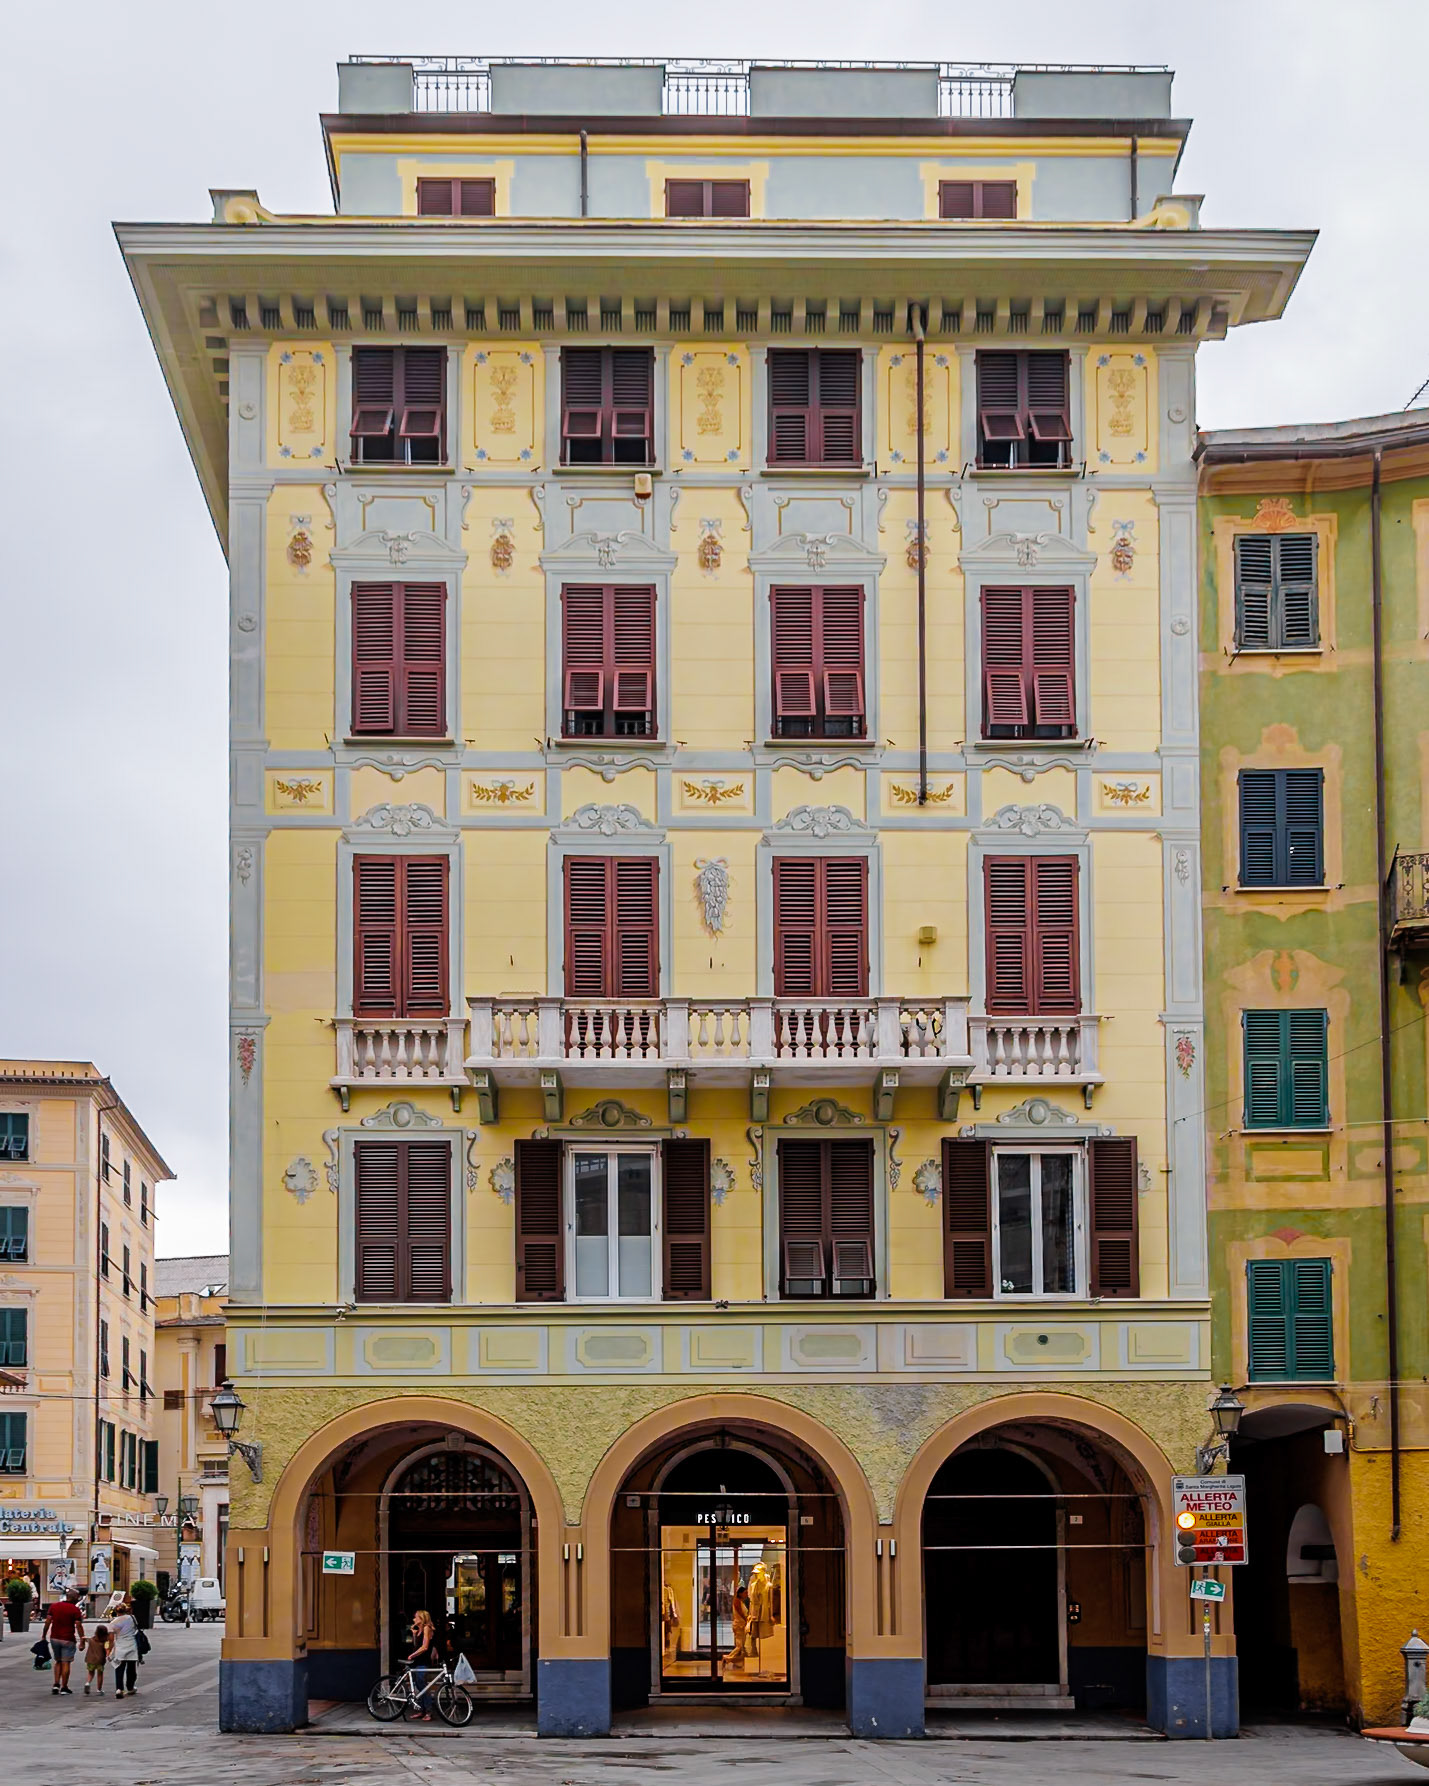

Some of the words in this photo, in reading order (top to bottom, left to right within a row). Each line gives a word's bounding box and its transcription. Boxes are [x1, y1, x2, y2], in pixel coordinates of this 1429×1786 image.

[1181, 1492, 1237, 1502] ALLERTA
[1186, 1502, 1232, 1511] METEO
[98, 1512, 196, 1527] CINEMA
[697, 1513, 749, 1524] PESICO
[0, 1520, 73, 1533] Centrale
